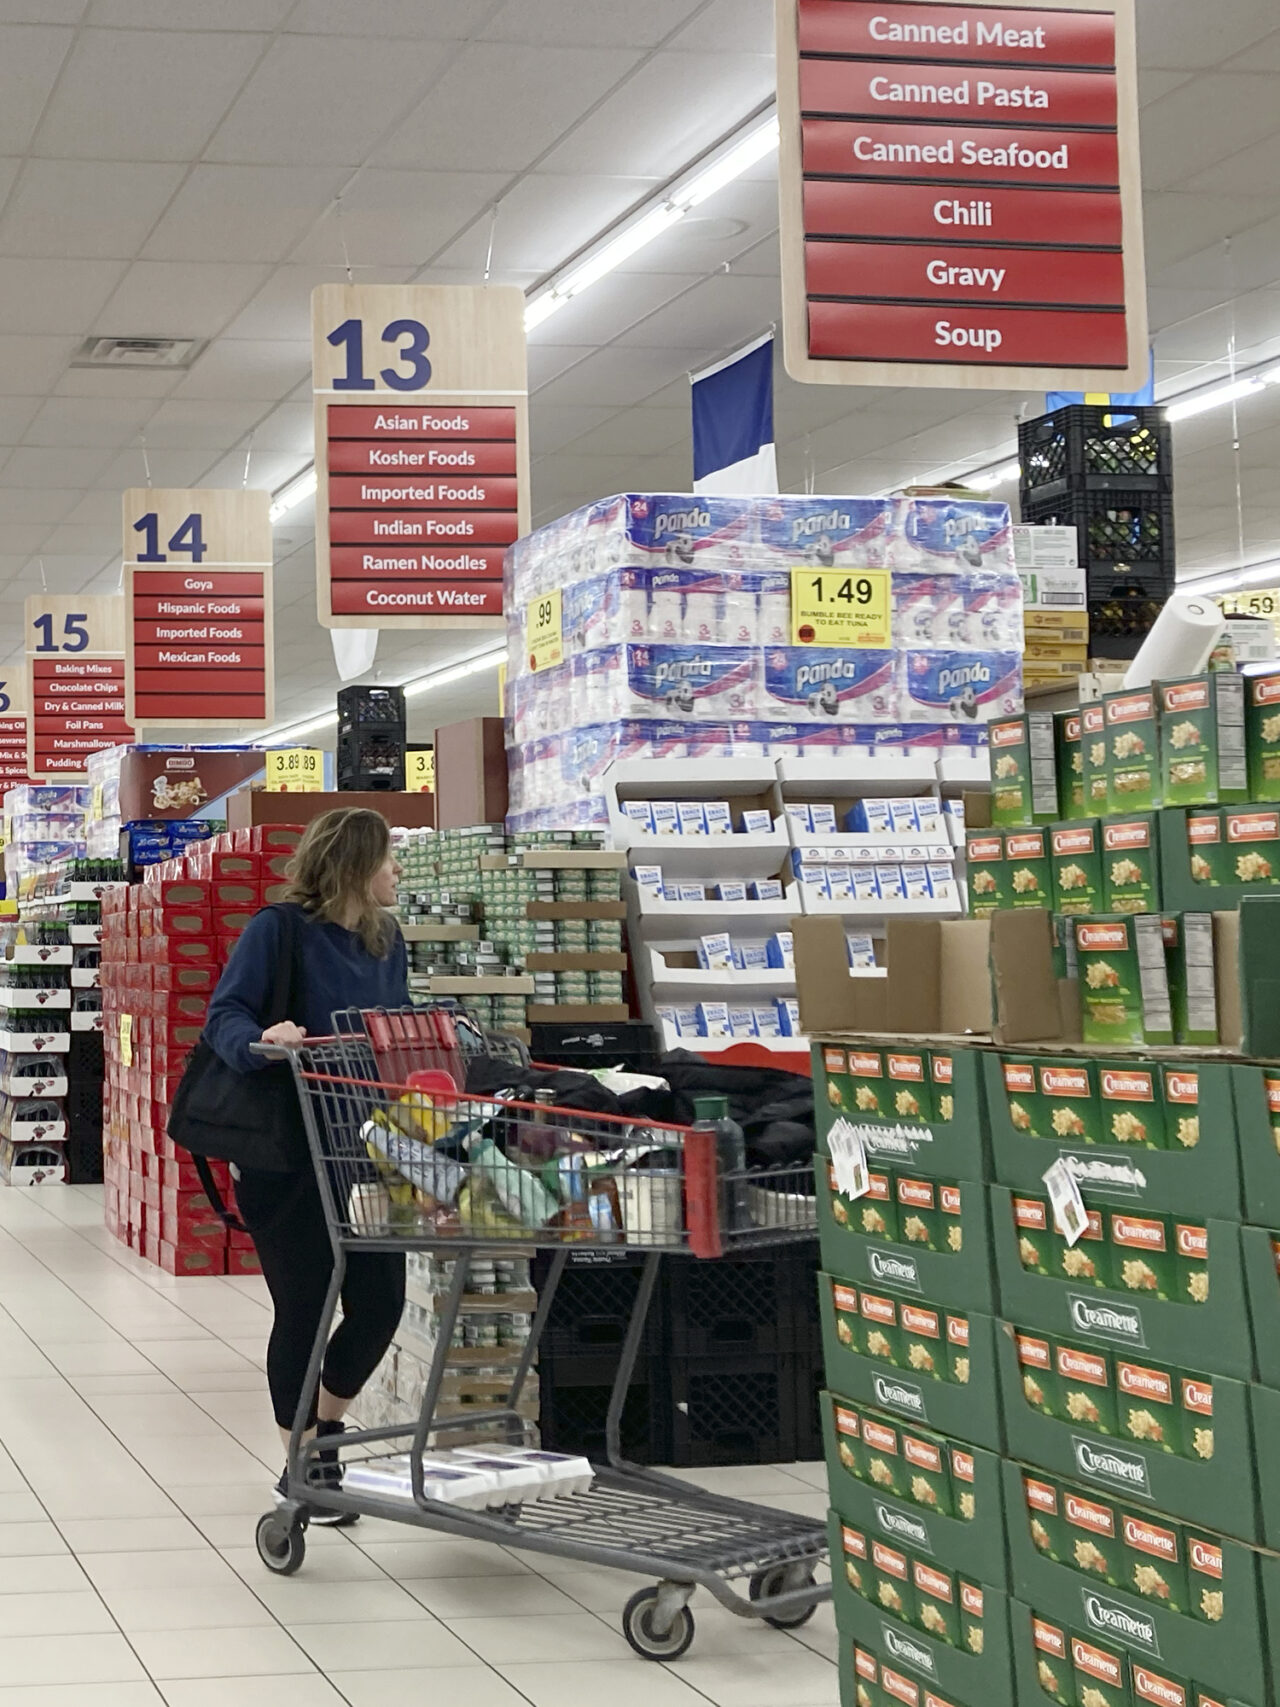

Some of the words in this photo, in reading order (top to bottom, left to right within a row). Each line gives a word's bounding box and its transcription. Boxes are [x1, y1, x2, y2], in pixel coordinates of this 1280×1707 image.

[869, 17, 968, 45] Canned
[977, 22, 1046, 49] Meat
[870, 77, 969, 104] Canned
[977, 82, 1049, 109] Pasta
[854, 137, 954, 164] Canned
[961, 141, 1069, 169] Seafood
[933, 200, 993, 226] Chili
[926, 260, 1006, 291] Gravy
[934, 321, 1002, 352] Soup
[326, 319, 432, 391] 13
[374, 415, 418, 431] Asian
[422, 415, 470, 431] Foods
[369, 450, 426, 466] Kosher
[428, 450, 476, 466] Foods
[361, 485, 435, 503] Imported
[438, 486, 485, 501] Foods
[133, 513, 208, 563] 14
[373, 520, 423, 536] Indian
[426, 521, 474, 536] Foods
[363, 555, 417, 570] Ramen
[422, 556, 487, 571] Noodles
[184, 578, 213, 592] Goya
[811, 577, 873, 604] 1.49
[366, 590, 432, 606] Coconut
[434, 591, 487, 606] Water
[158, 602, 205, 616] Hispanic
[208, 603, 241, 614] Foods
[536, 601, 552, 629] .99
[33, 613, 89, 652] 15
[156, 627, 207, 640] Imported
[209, 627, 242, 639] Foods
[158, 651, 206, 663] Mexican
[208, 652, 241, 663] Foods
[55, 664, 85, 675] Baking
[86, 664, 113, 674] Mixes
[796, 658, 855, 692] panda
[939, 662, 991, 694] panda
[49, 682, 93, 692] Chocolate
[94, 683, 118, 693] Chips
[44, 701, 60, 712] Dry
[61, 701, 69, 711] &
[70, 701, 104, 711] Canned
[105, 701, 125, 711] Milk
[14, 721, 26, 730] Oil
[65, 720, 82, 730] Foil
[83, 720, 104, 730] Pans
[54, 738, 116, 748] Marshmallows
[5, 766, 27, 776] Spices
[46, 758, 82, 769] Pudding
[276, 754, 300, 771] 3.89
[1103, 1074, 1149, 1094] Creamette
[1114, 1220, 1162, 1243] Creamette
[1072, 1300, 1140, 1334] Creamette
[1120, 1368, 1168, 1394] Creamette
[1077, 1444, 1145, 1483] Creamette
[1125, 1522, 1174, 1552] Creamette
[1087, 1597, 1154, 1643] Creamette
[885, 1629, 933, 1670] Creamette
